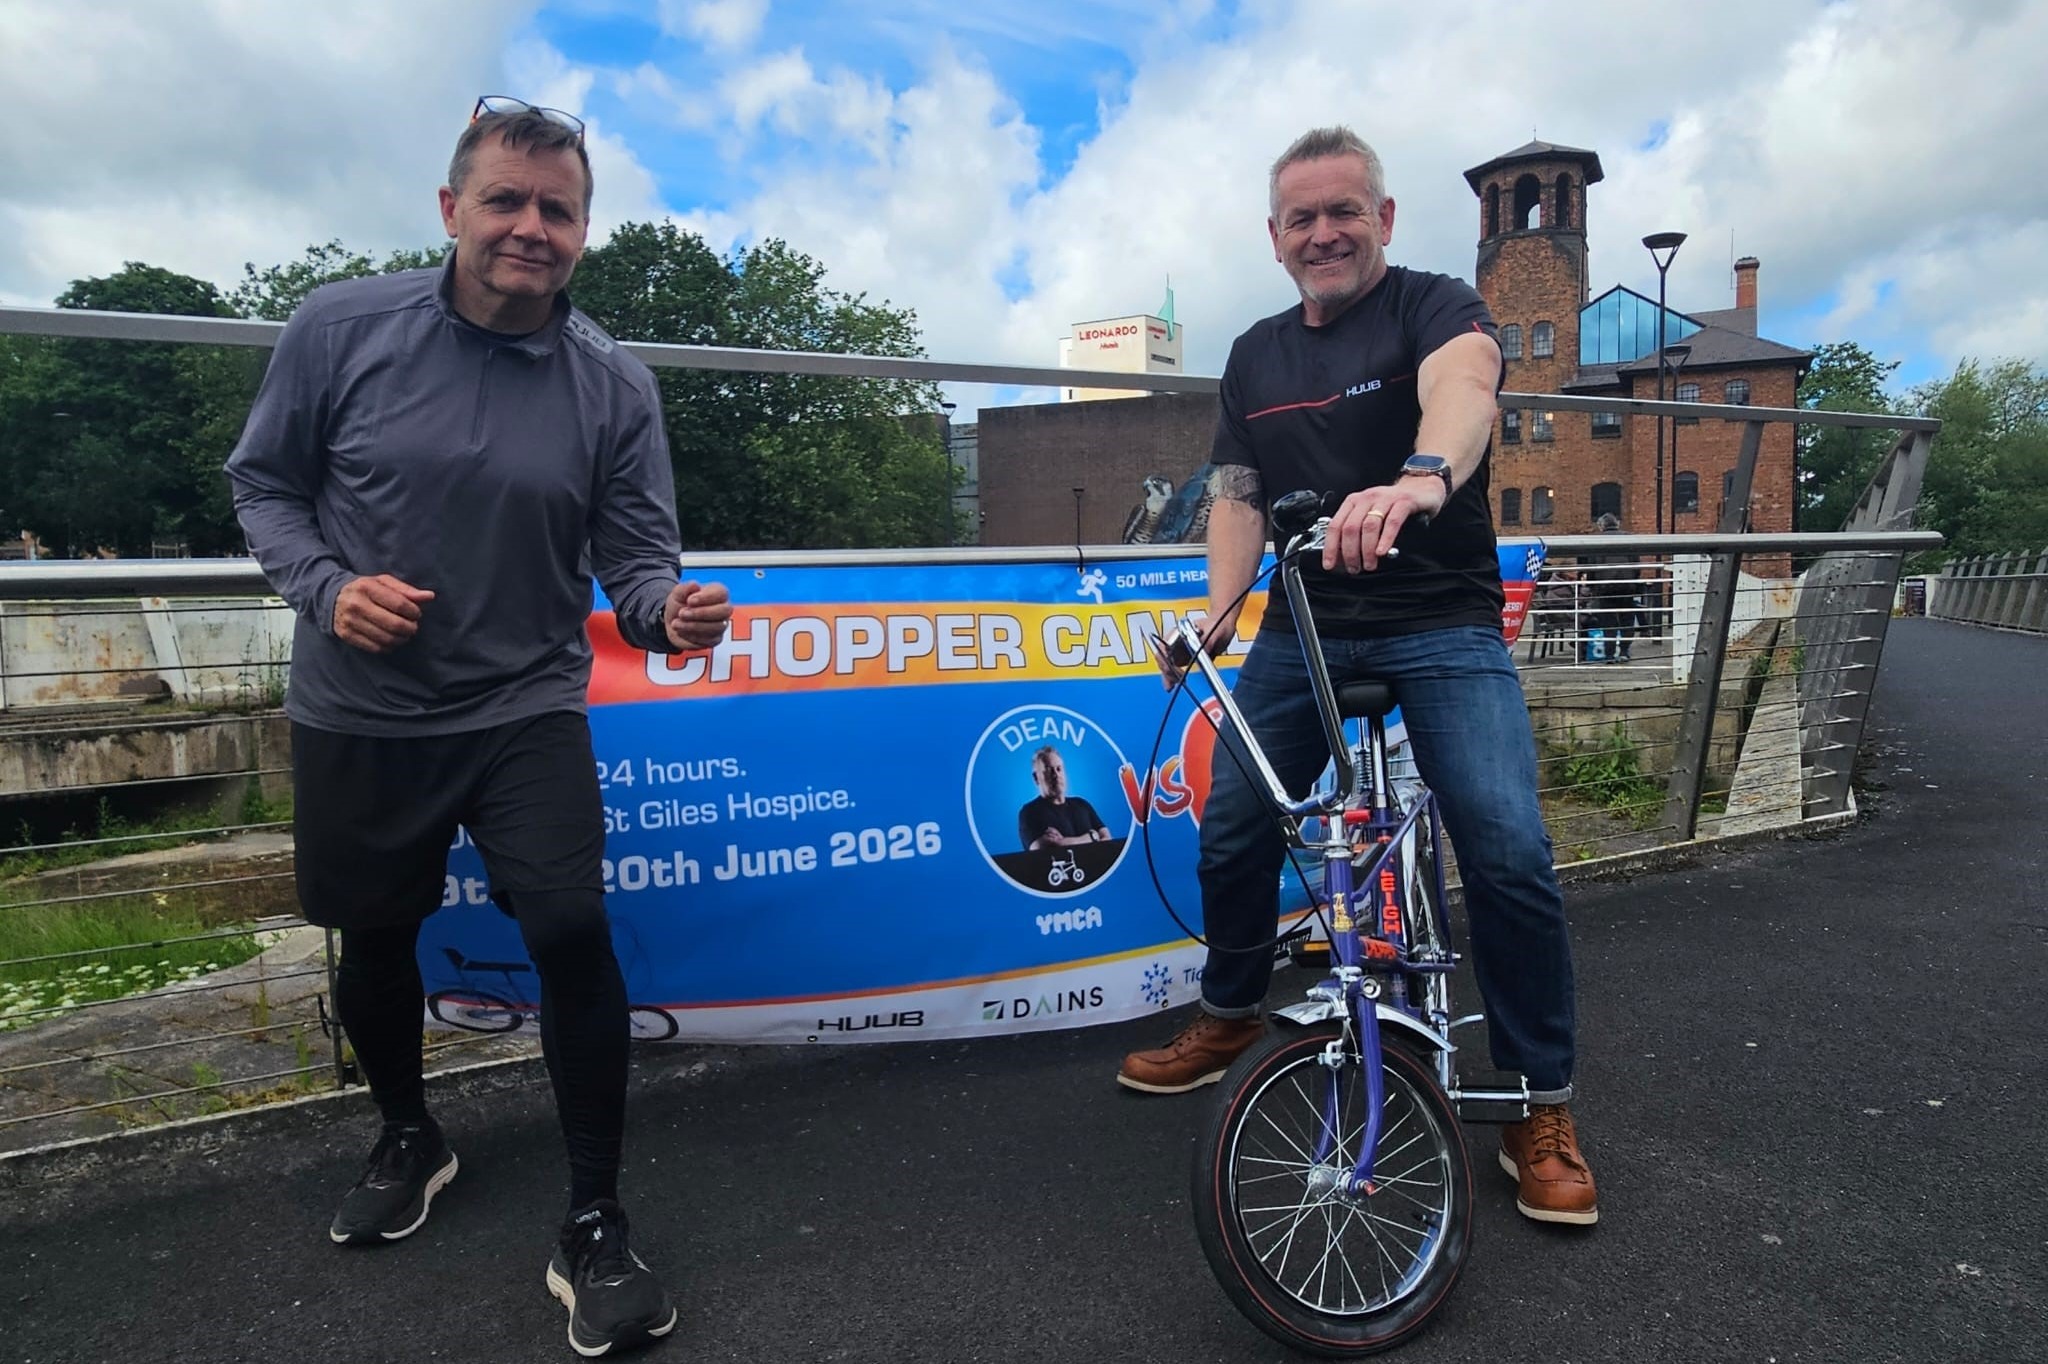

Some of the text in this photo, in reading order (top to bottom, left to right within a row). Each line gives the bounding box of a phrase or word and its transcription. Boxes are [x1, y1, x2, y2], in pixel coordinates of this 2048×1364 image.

[1079, 325, 1138, 341] LEONARDO
[1346, 379, 1382, 398] HUUB
[1115, 570, 1209, 589] 50 MILE HEA
[645, 612, 1026, 686] CHOPPER
[998, 716, 1086, 753] DEAN
[596, 756, 747, 789] 24 hours.
[639, 798, 718, 829] Giles
[727, 785, 857, 821] Hospice.
[713, 843, 818, 881] June
[829, 822, 942, 868] 2026
[1035, 905, 1103, 936] YMCA
[817, 985, 1104, 1032] HUUB DAINS
